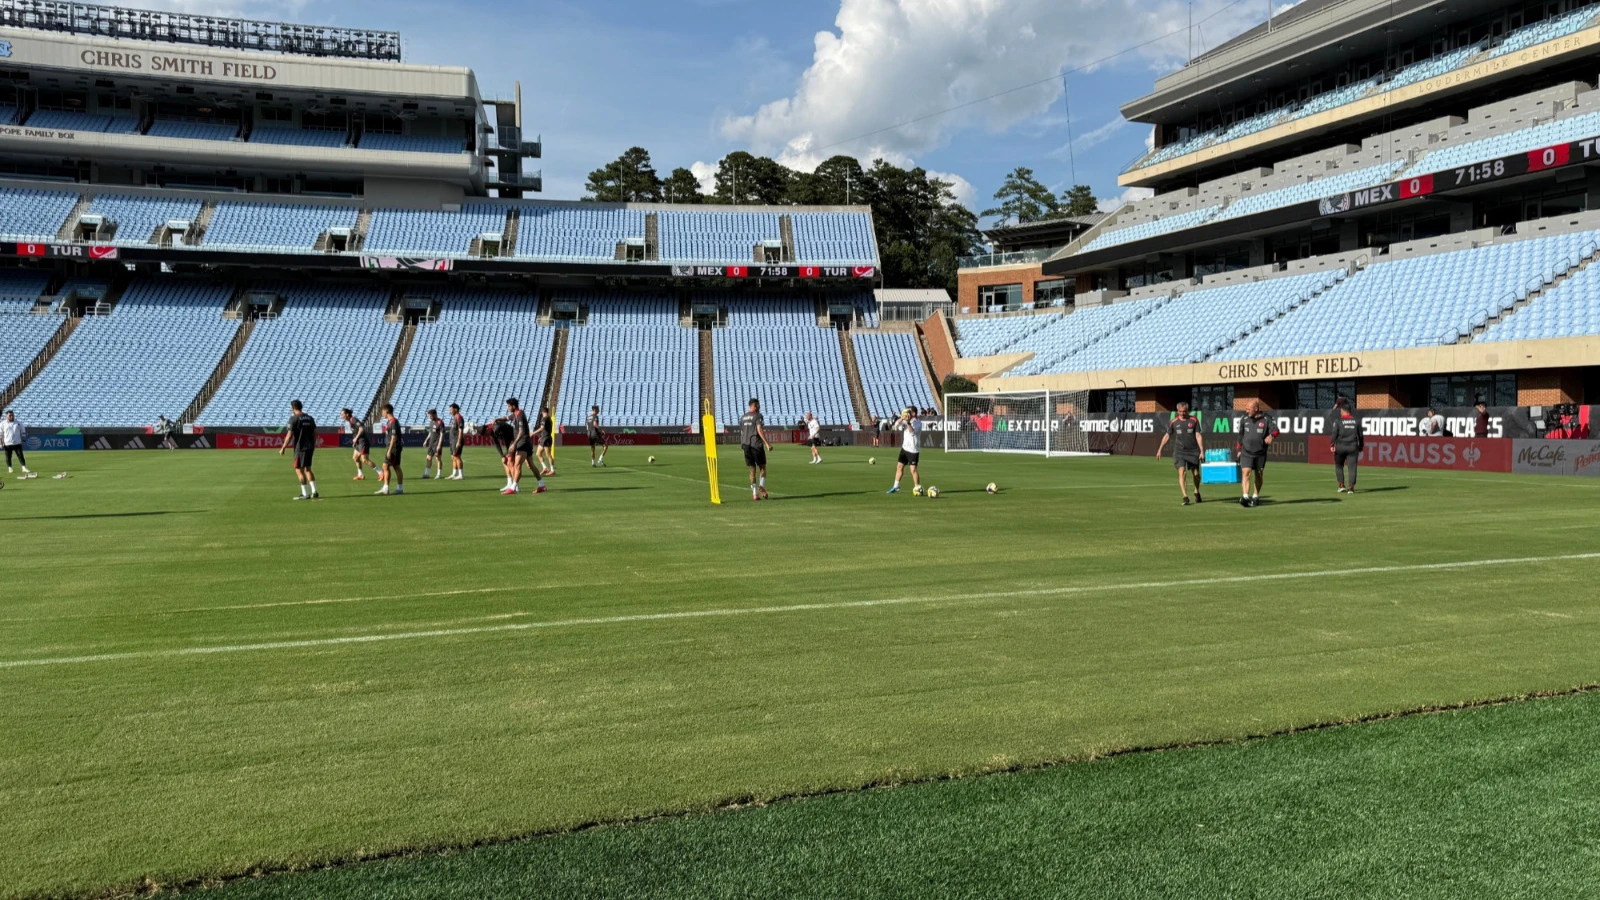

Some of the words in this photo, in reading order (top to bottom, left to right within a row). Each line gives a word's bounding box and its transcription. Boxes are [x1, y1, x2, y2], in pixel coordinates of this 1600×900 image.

[80, 50, 142, 69] CHRIS
[151, 56, 213, 76] SMITH
[222, 62, 277, 80] FIELD
[1419, 59, 1508, 93] LOUDERMILK
[1520, 37, 1581, 62] CENTER
[25, 129, 54, 138] FAMILY
[1354, 185, 1393, 207] MEX
[1409, 178, 1420, 194] 0
[1455, 160, 1505, 185] 71:58
[1543, 149, 1555, 166] 0
[27, 244, 36, 254] 0
[51, 245, 82, 256] TUR
[697, 266, 723, 276] MEX
[733, 266, 740, 276] 0
[760, 267, 788, 276] 71:58
[806, 266, 812, 276] 0
[824, 267, 847, 276] TUR
[1219, 363, 1258, 379] CHRIS
[1264, 360, 1309, 376] SMITH
[1316, 357, 1360, 374] FIELD
[43, 438, 71, 448] AT&T
